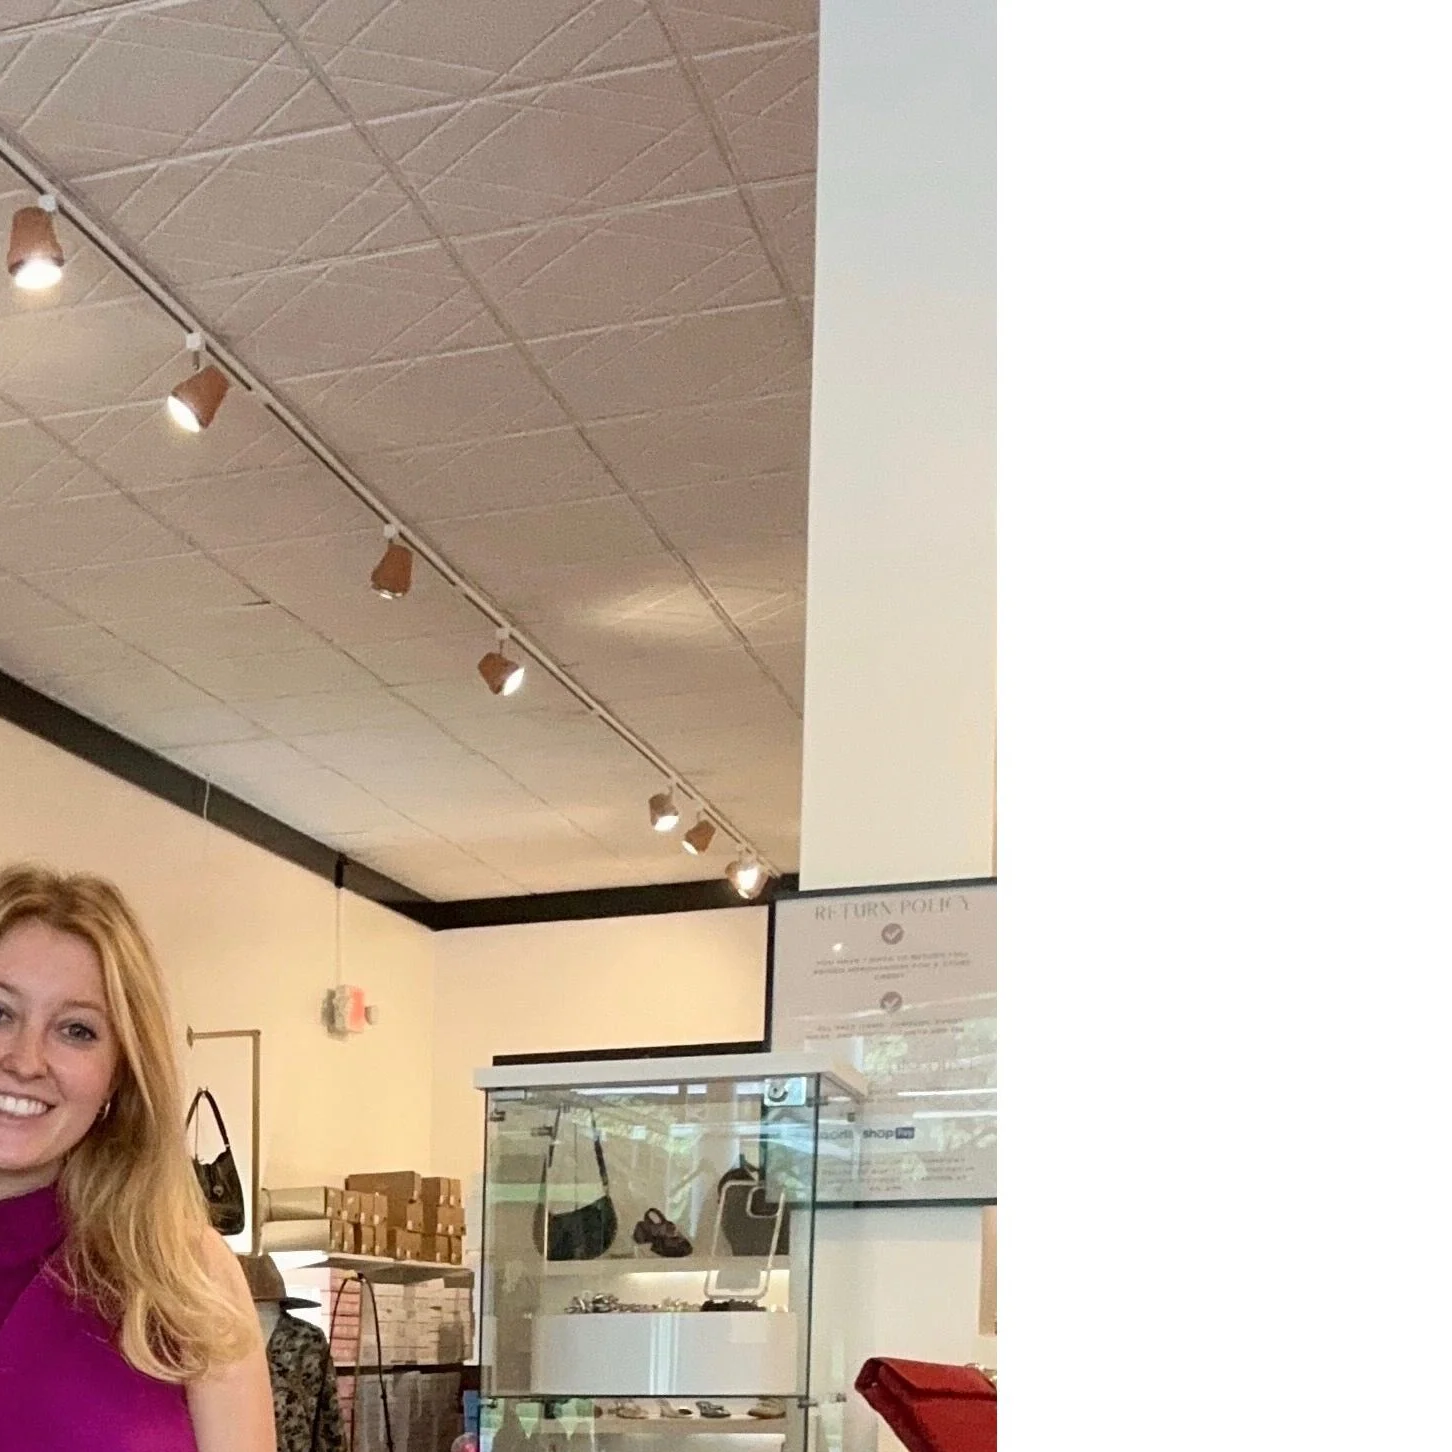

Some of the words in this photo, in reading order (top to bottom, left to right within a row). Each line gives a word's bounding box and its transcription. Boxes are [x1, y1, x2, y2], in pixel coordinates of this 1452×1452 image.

[814, 900, 891, 921] RETURN
[899, 894, 970, 915] POLICY
[863, 1128, 893, 1140] shop
